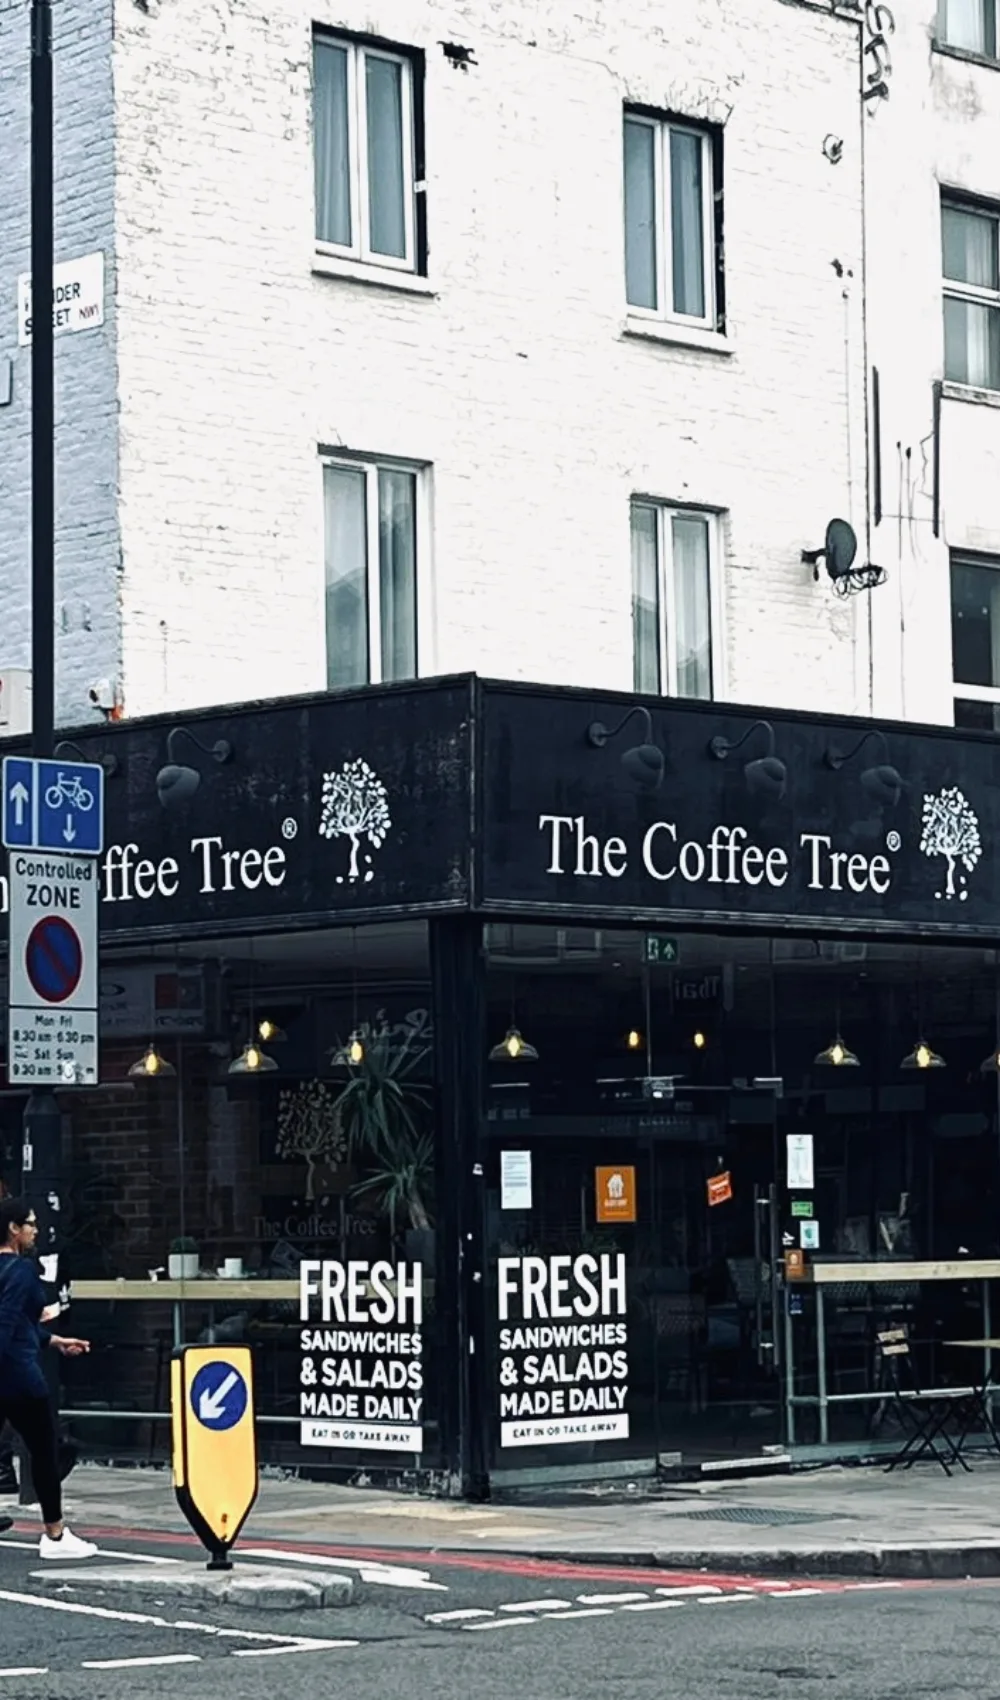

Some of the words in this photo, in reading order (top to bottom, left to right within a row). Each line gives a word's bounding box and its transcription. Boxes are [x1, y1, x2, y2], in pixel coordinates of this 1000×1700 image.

[539, 815, 627, 877] The
[642, 822, 788, 887] Coffee
[15, 857, 92, 881] Controlled
[97, 843, 179, 901] ffee
[26, 884, 81, 909] ZONE
[34, 1048, 51, 1060] Sat
[56, 1048, 74, 1060] Sun
[300, 1260, 422, 1324] FRESH
[498, 1253, 626, 1320] FRESH
[300, 1330, 422, 1355] SANDWICHES
[499, 1323, 627, 1350] SANDWICHES
[300, 1357, 317, 1386] &
[321, 1358, 423, 1390] SALADS
[500, 1356, 518, 1386] &
[523, 1350, 628, 1384] SALADS
[300, 1392, 359, 1417] MADE
[365, 1395, 422, 1421] DAILY
[500, 1390, 564, 1417] MADE
[569, 1386, 628, 1412] DAILY
[312, 1428, 328, 1438] EAT
[331, 1430, 340, 1439] IN
[343, 1430, 356, 1440] OR
[359, 1431, 381, 1441] TAKE
[385, 1433, 410, 1443] AWAY
[513, 1428, 531, 1438] EAT
[534, 1427, 544, 1436] IN
[547, 1426, 560, 1436] OR
[564, 1424, 587, 1434] TAKE
[591, 1422, 617, 1432] AWAY
